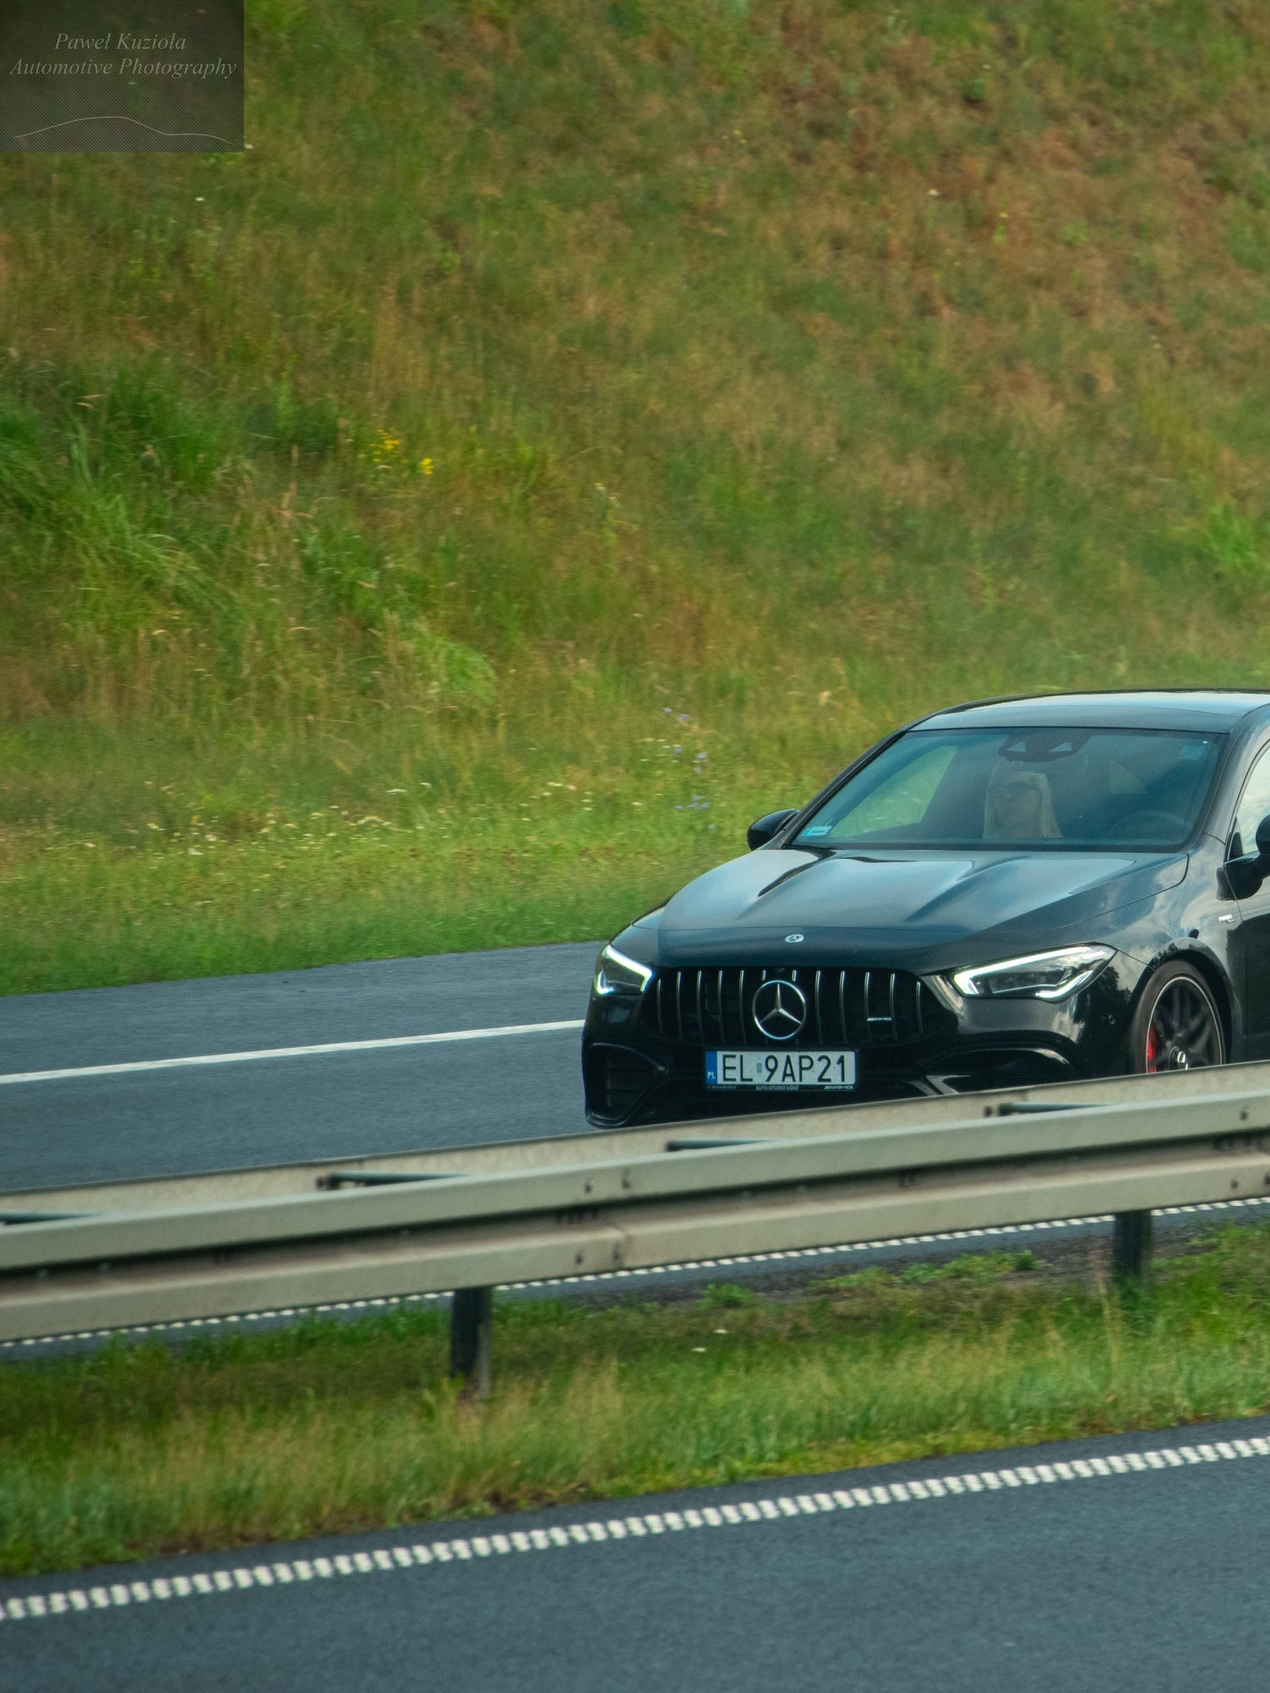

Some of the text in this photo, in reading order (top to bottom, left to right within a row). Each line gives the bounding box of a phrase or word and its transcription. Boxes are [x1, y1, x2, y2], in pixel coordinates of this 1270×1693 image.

[707, 1071, 716, 1079] PL
[723, 1054, 846, 1083] EL 9AP21
